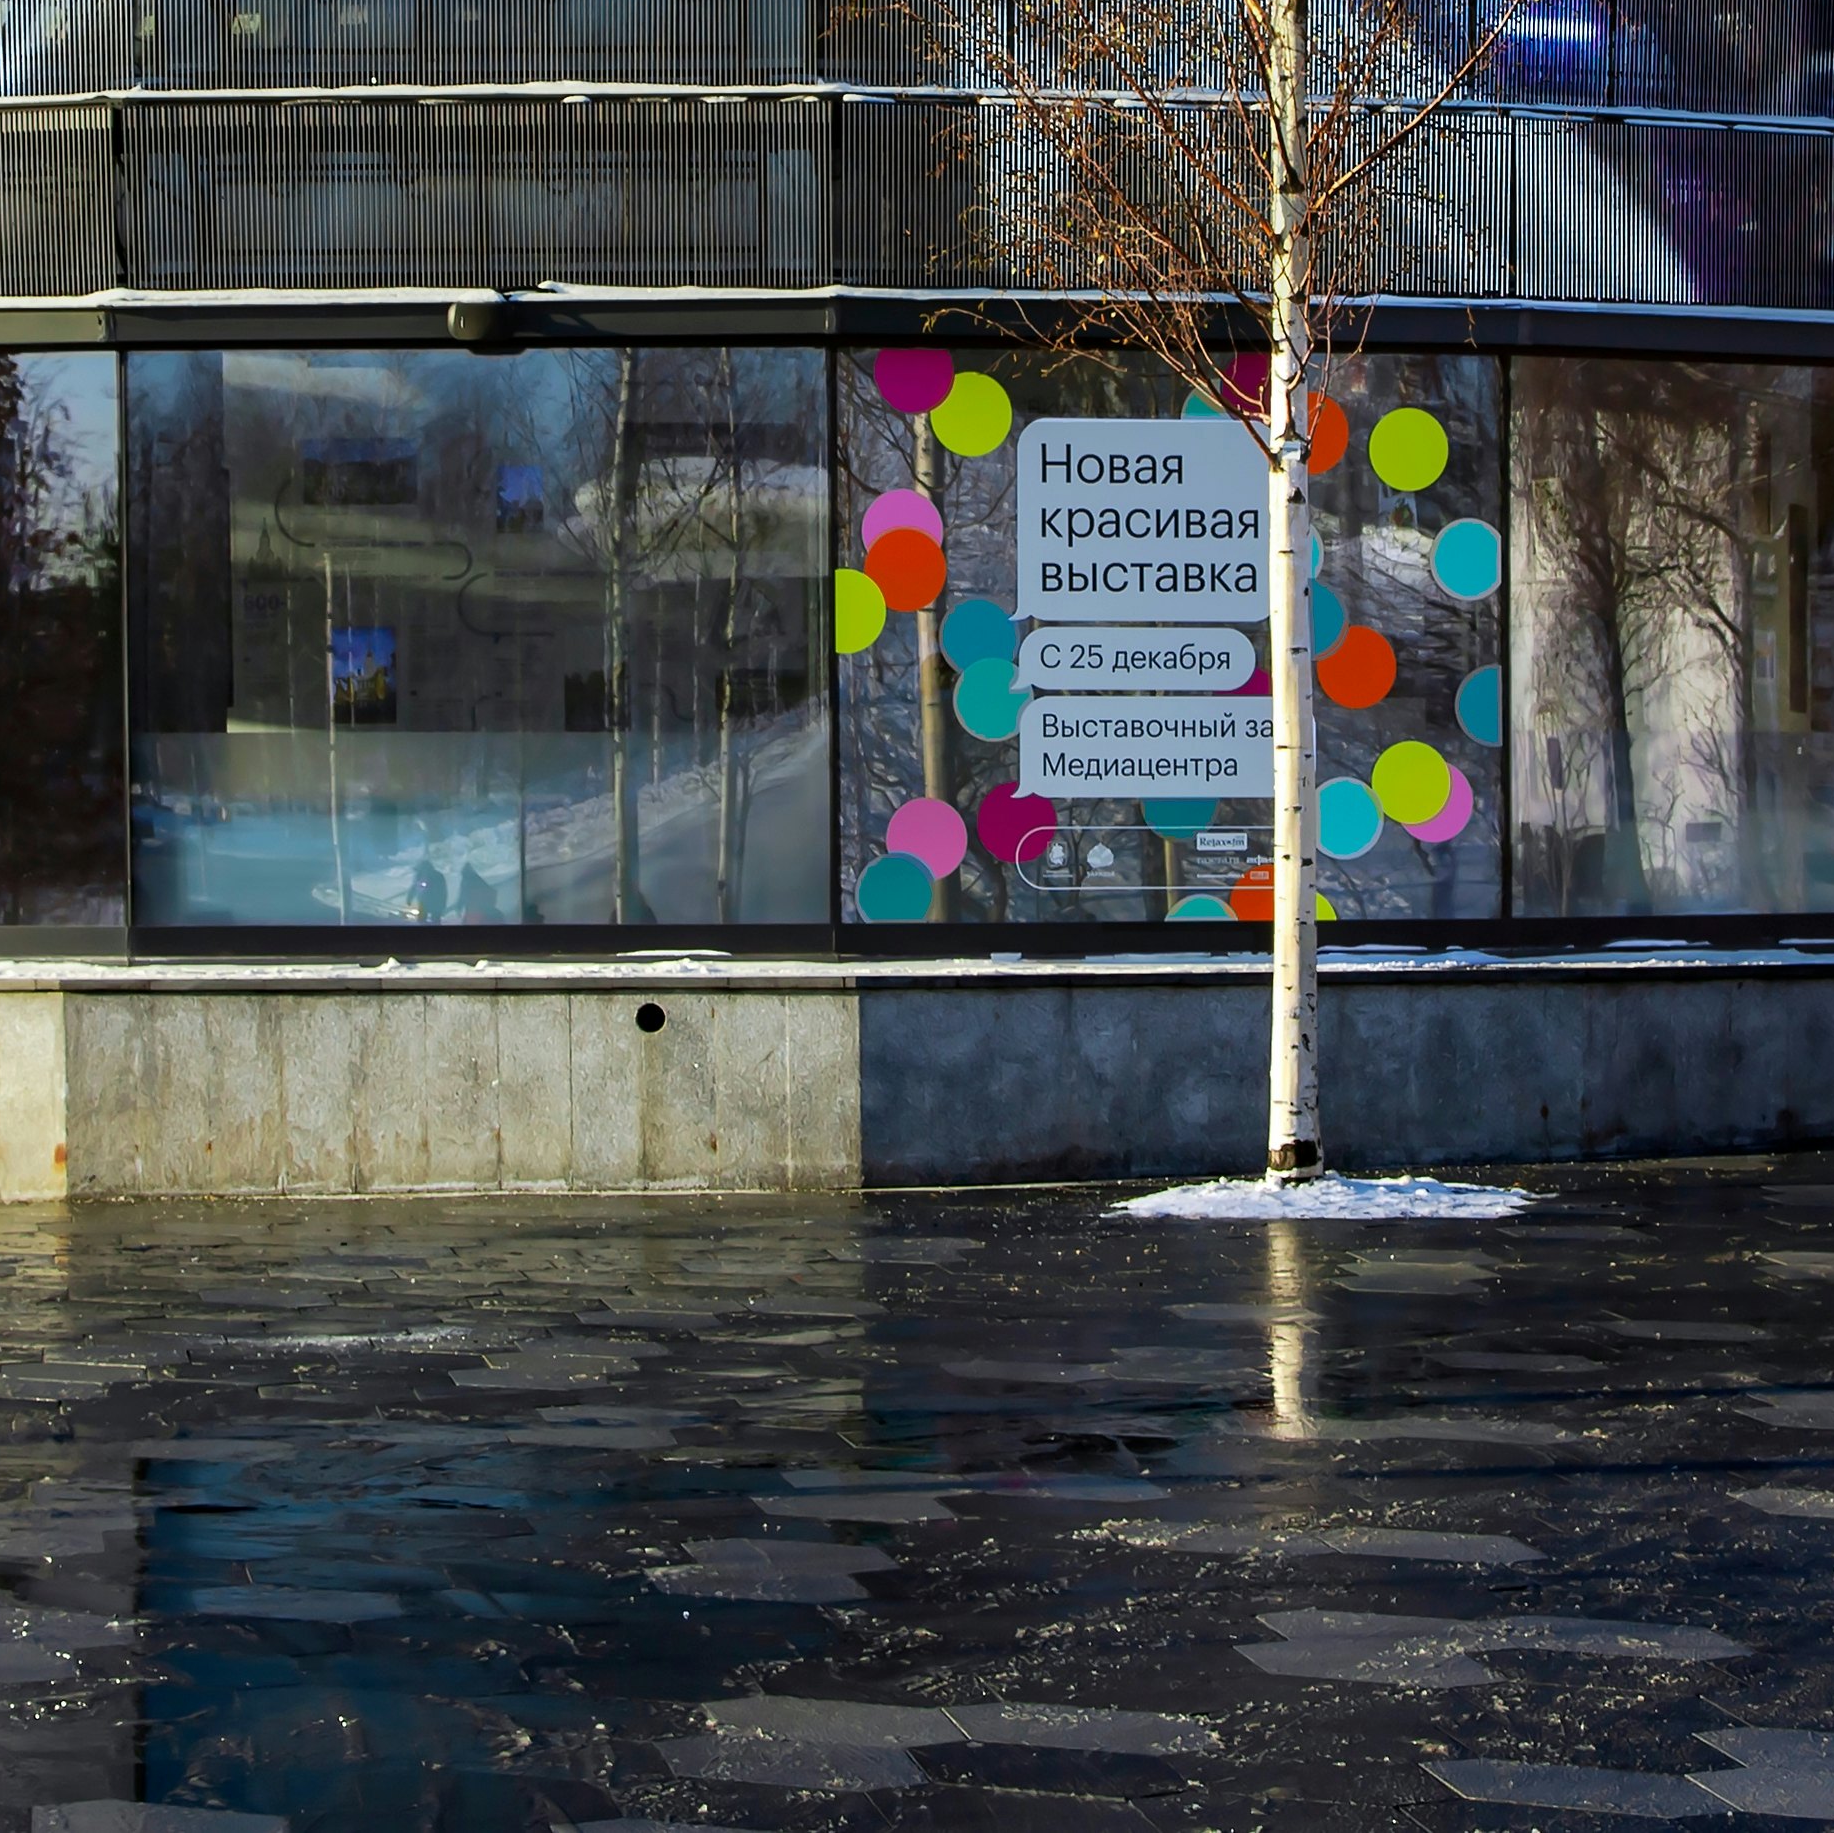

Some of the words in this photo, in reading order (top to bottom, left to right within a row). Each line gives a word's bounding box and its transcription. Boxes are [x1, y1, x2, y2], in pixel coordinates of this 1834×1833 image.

[1040, 442, 1184, 485] Новая
[1040, 507, 1260, 548] красивая
[1041, 562, 1258, 594] выставка
[1039, 643, 1062, 669] С
[1070, 643, 1104, 669] 25
[1111, 642, 1231, 676] декабря
[1042, 711, 1236, 739] Выставочный
[1244, 718, 1274, 738] за
[1042, 751, 1238, 782] Медиацентра
